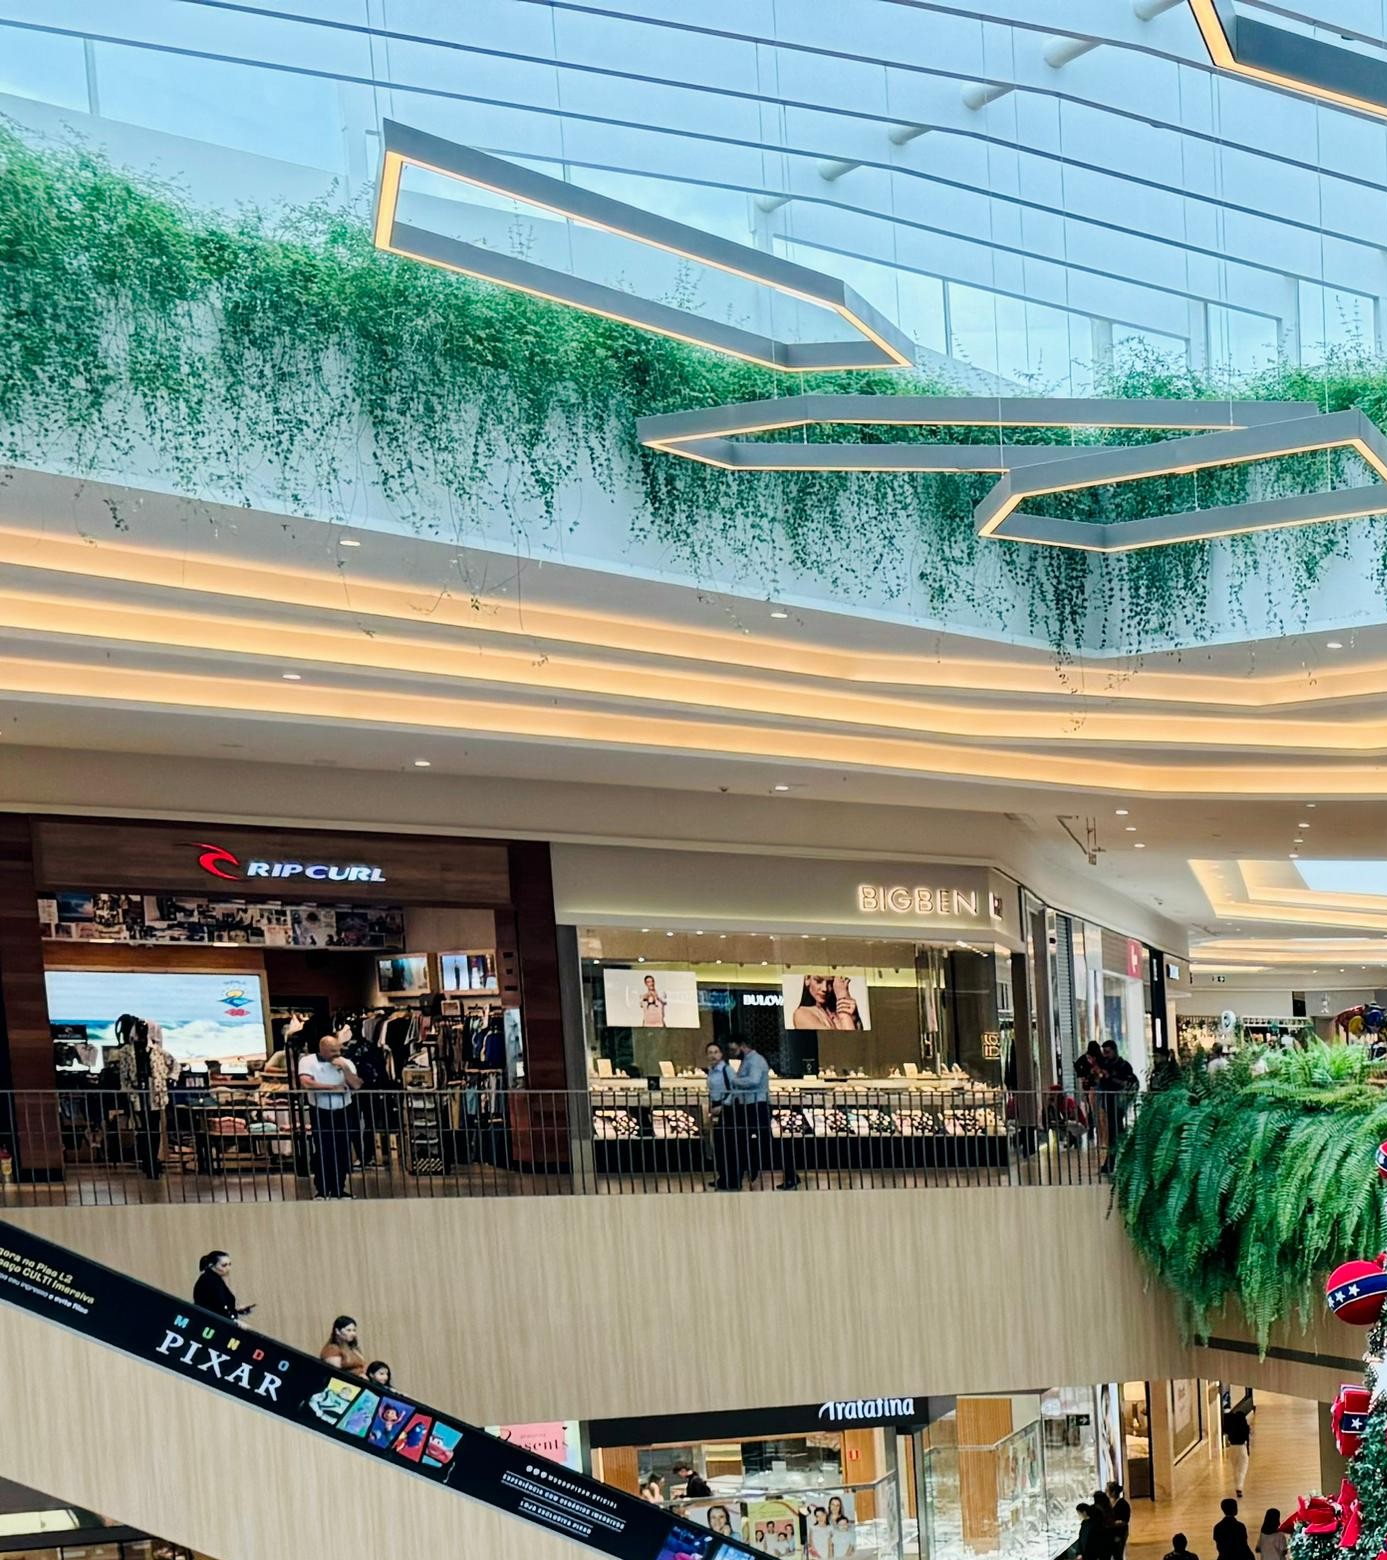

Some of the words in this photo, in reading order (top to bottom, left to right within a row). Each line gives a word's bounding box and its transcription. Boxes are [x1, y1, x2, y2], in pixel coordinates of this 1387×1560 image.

[743, 994, 784, 1007] BULOV
[155, 1329, 282, 1402] PIXAR
[174, 1314, 290, 1372] MUNDO
